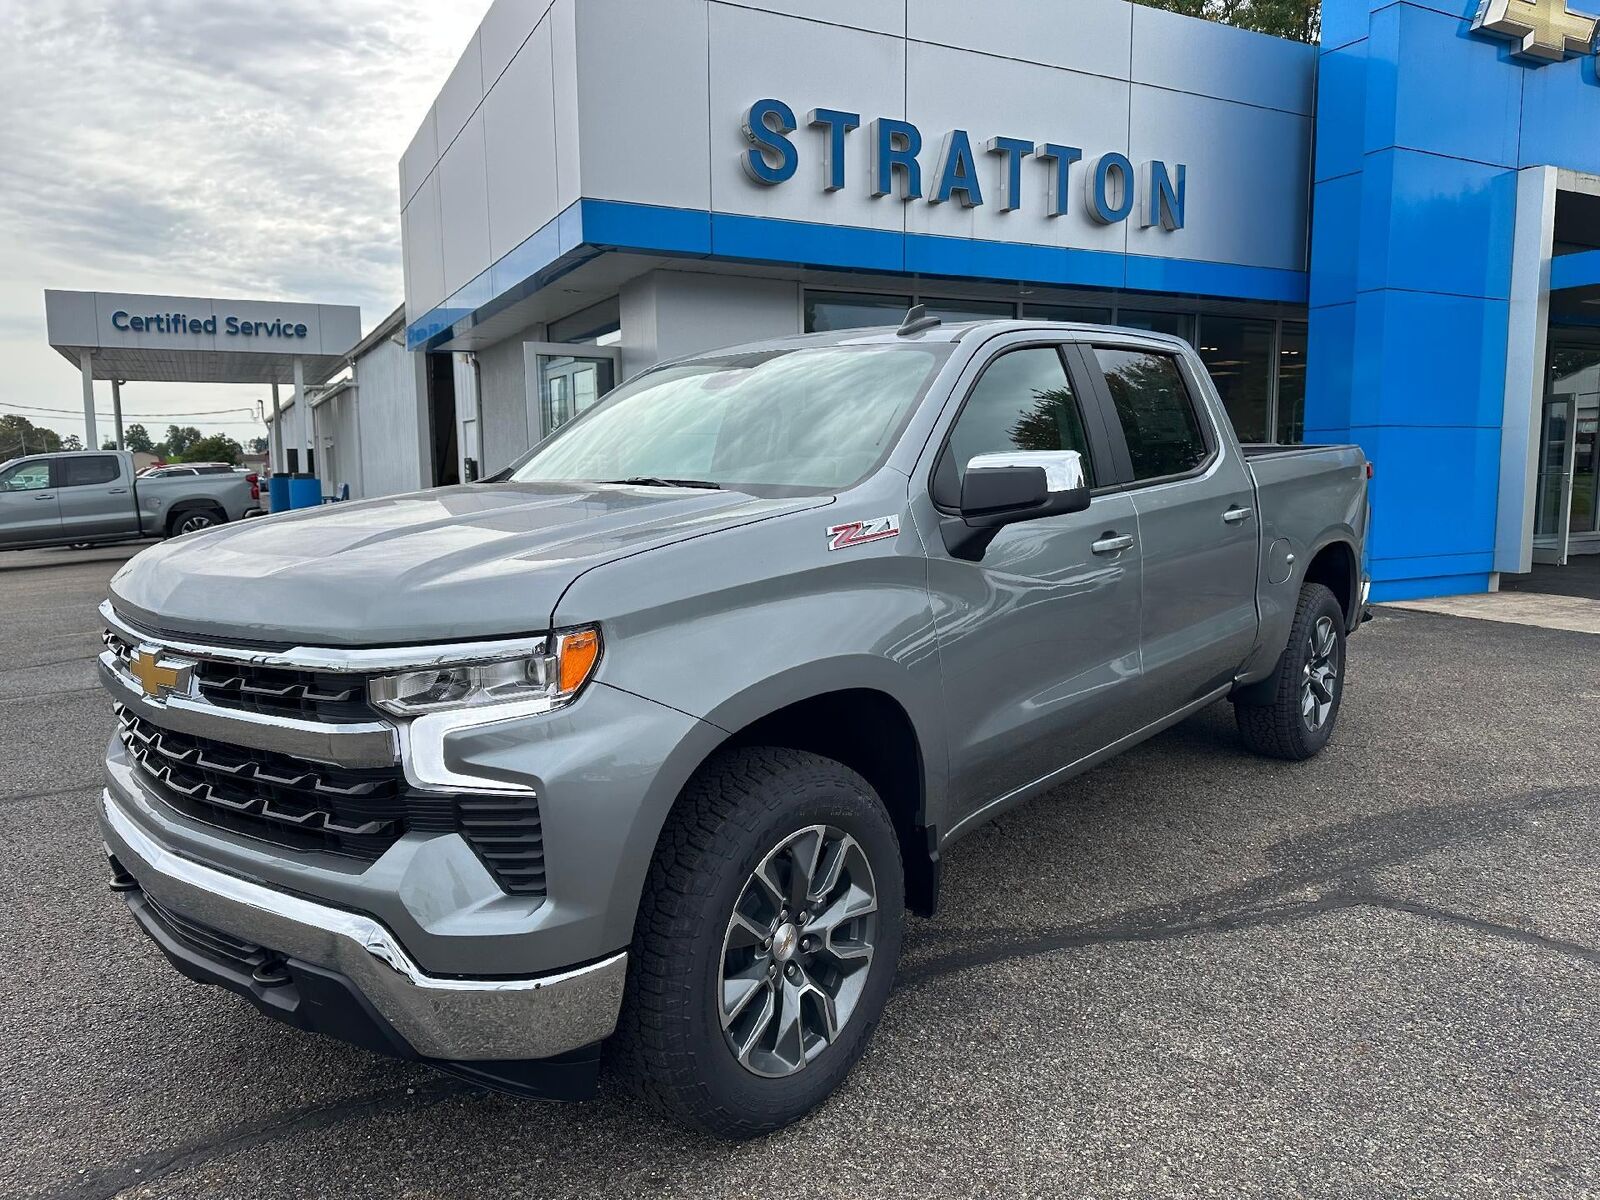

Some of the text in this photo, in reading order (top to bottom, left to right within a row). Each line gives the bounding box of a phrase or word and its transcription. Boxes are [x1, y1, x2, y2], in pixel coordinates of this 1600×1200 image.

[741, 98, 1187, 231] STRATTON
[112, 310, 308, 338] Certified Service
[826, 514, 900, 551] Z71
